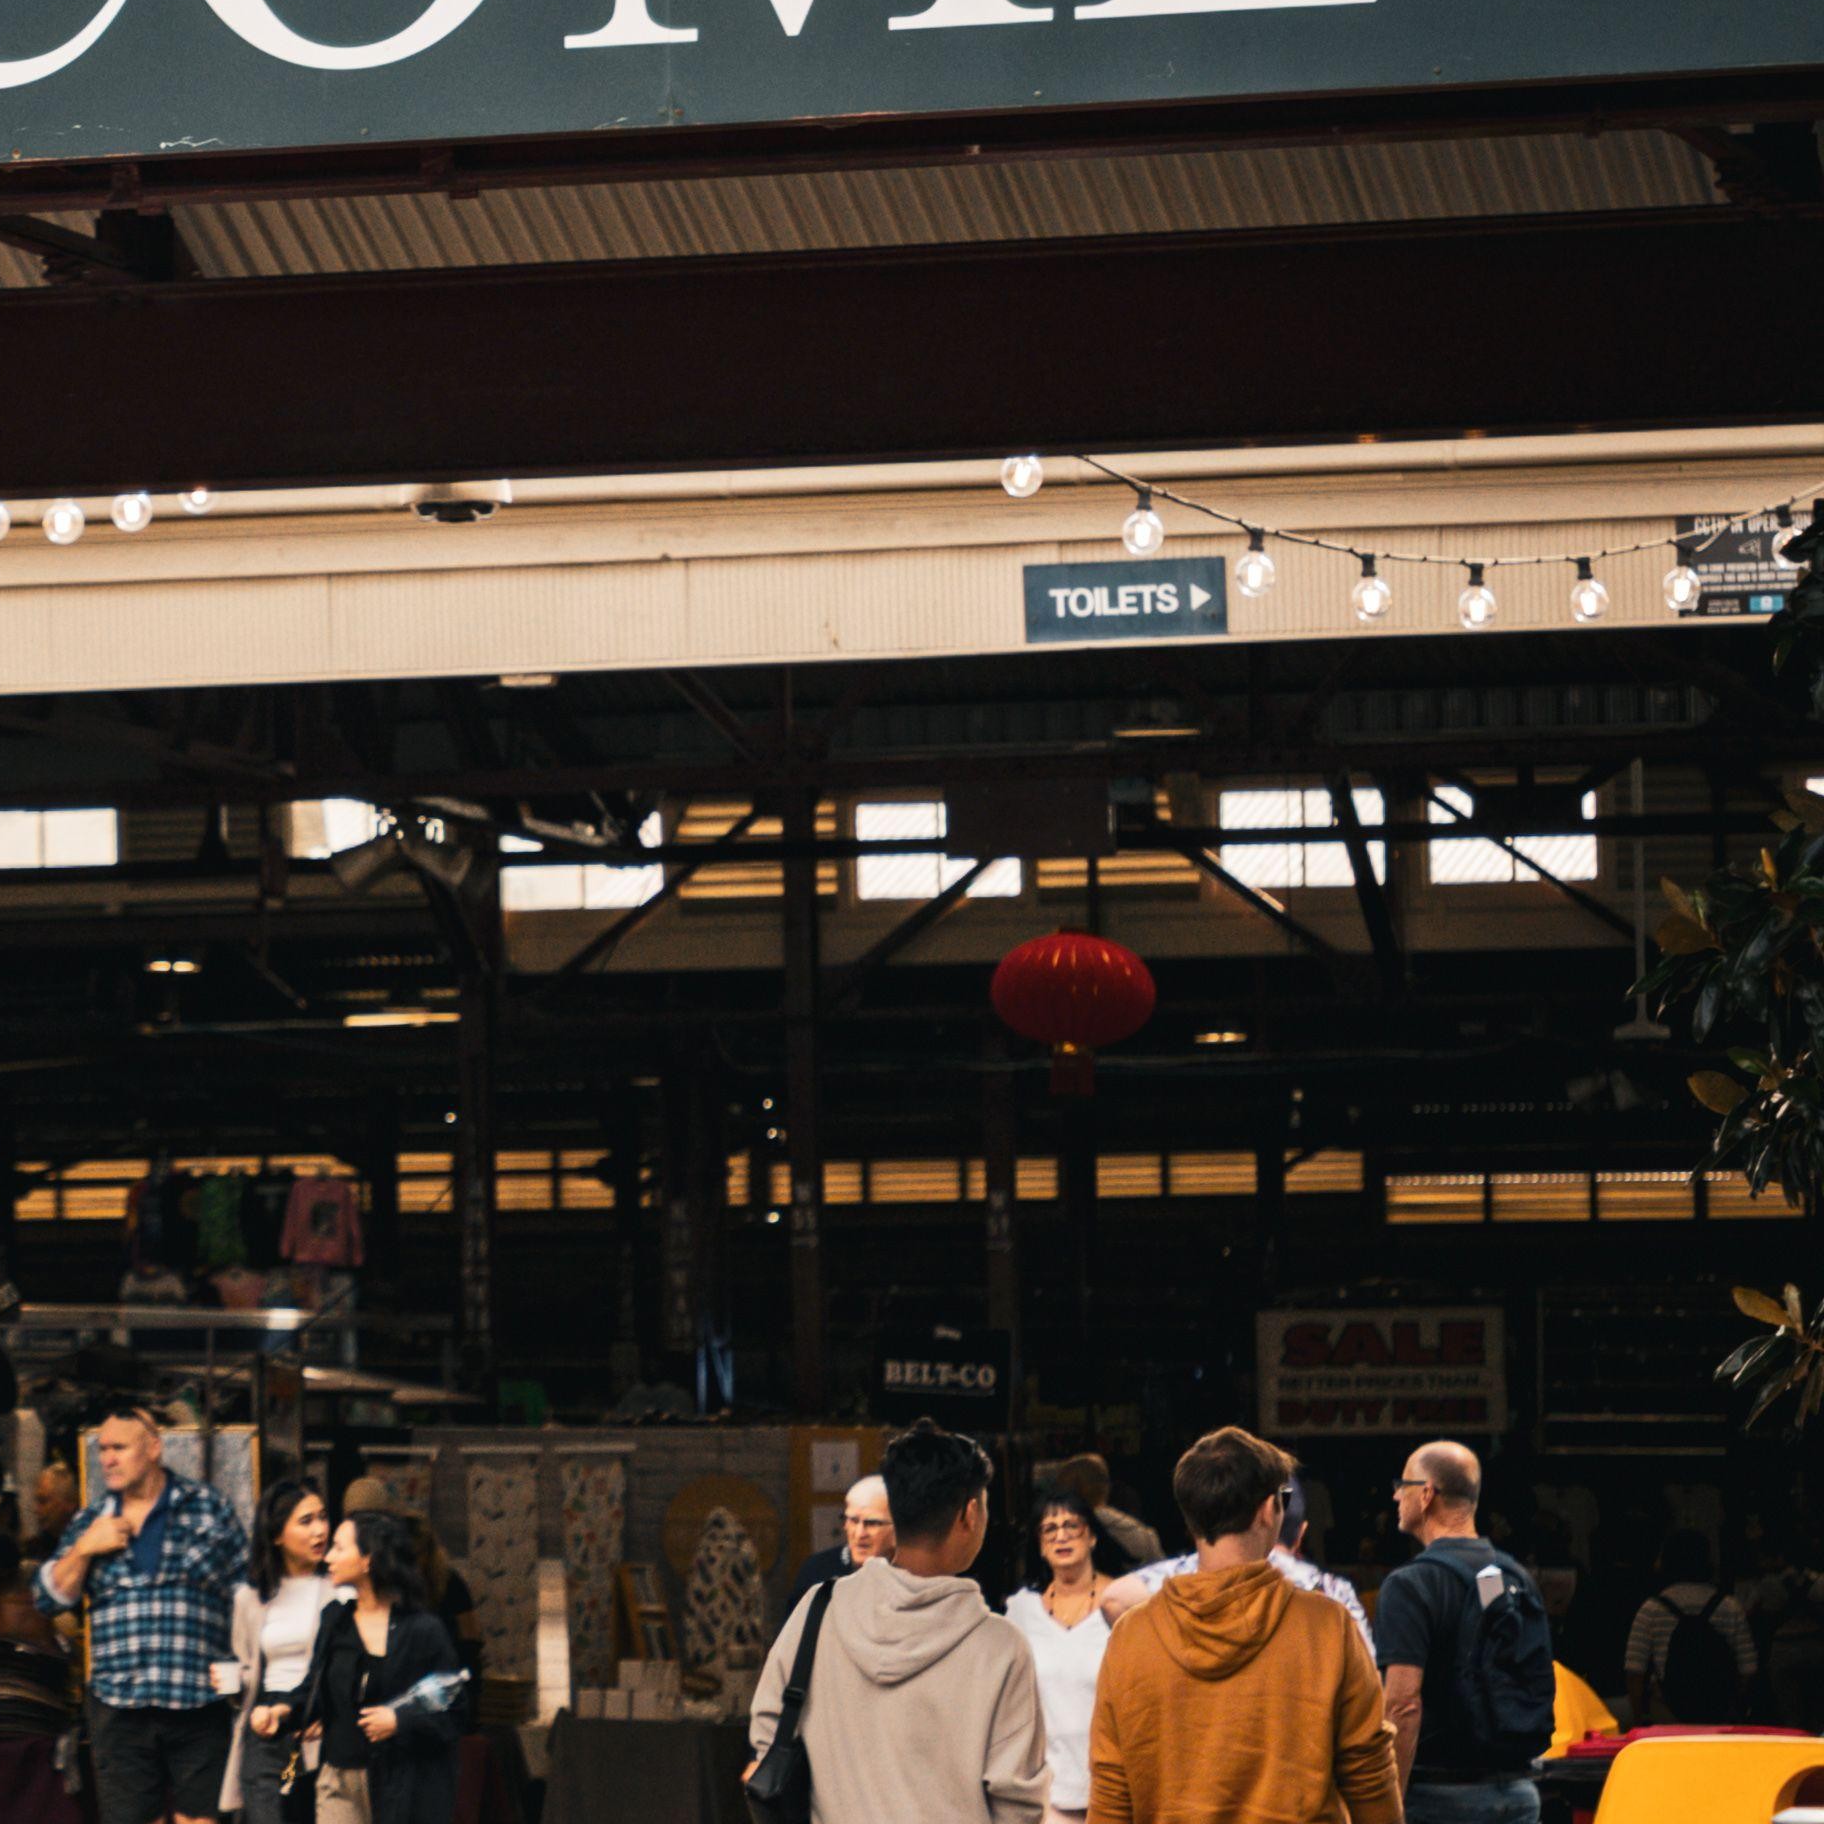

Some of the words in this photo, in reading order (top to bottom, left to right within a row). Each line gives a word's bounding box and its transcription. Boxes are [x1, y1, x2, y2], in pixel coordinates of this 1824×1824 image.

[1048, 582, 1180, 618] TOILETS
[1280, 1321, 1487, 1367] SALE
[883, 1359, 998, 1388] BELT-CO
[1277, 1398, 1383, 1425] DUTY
